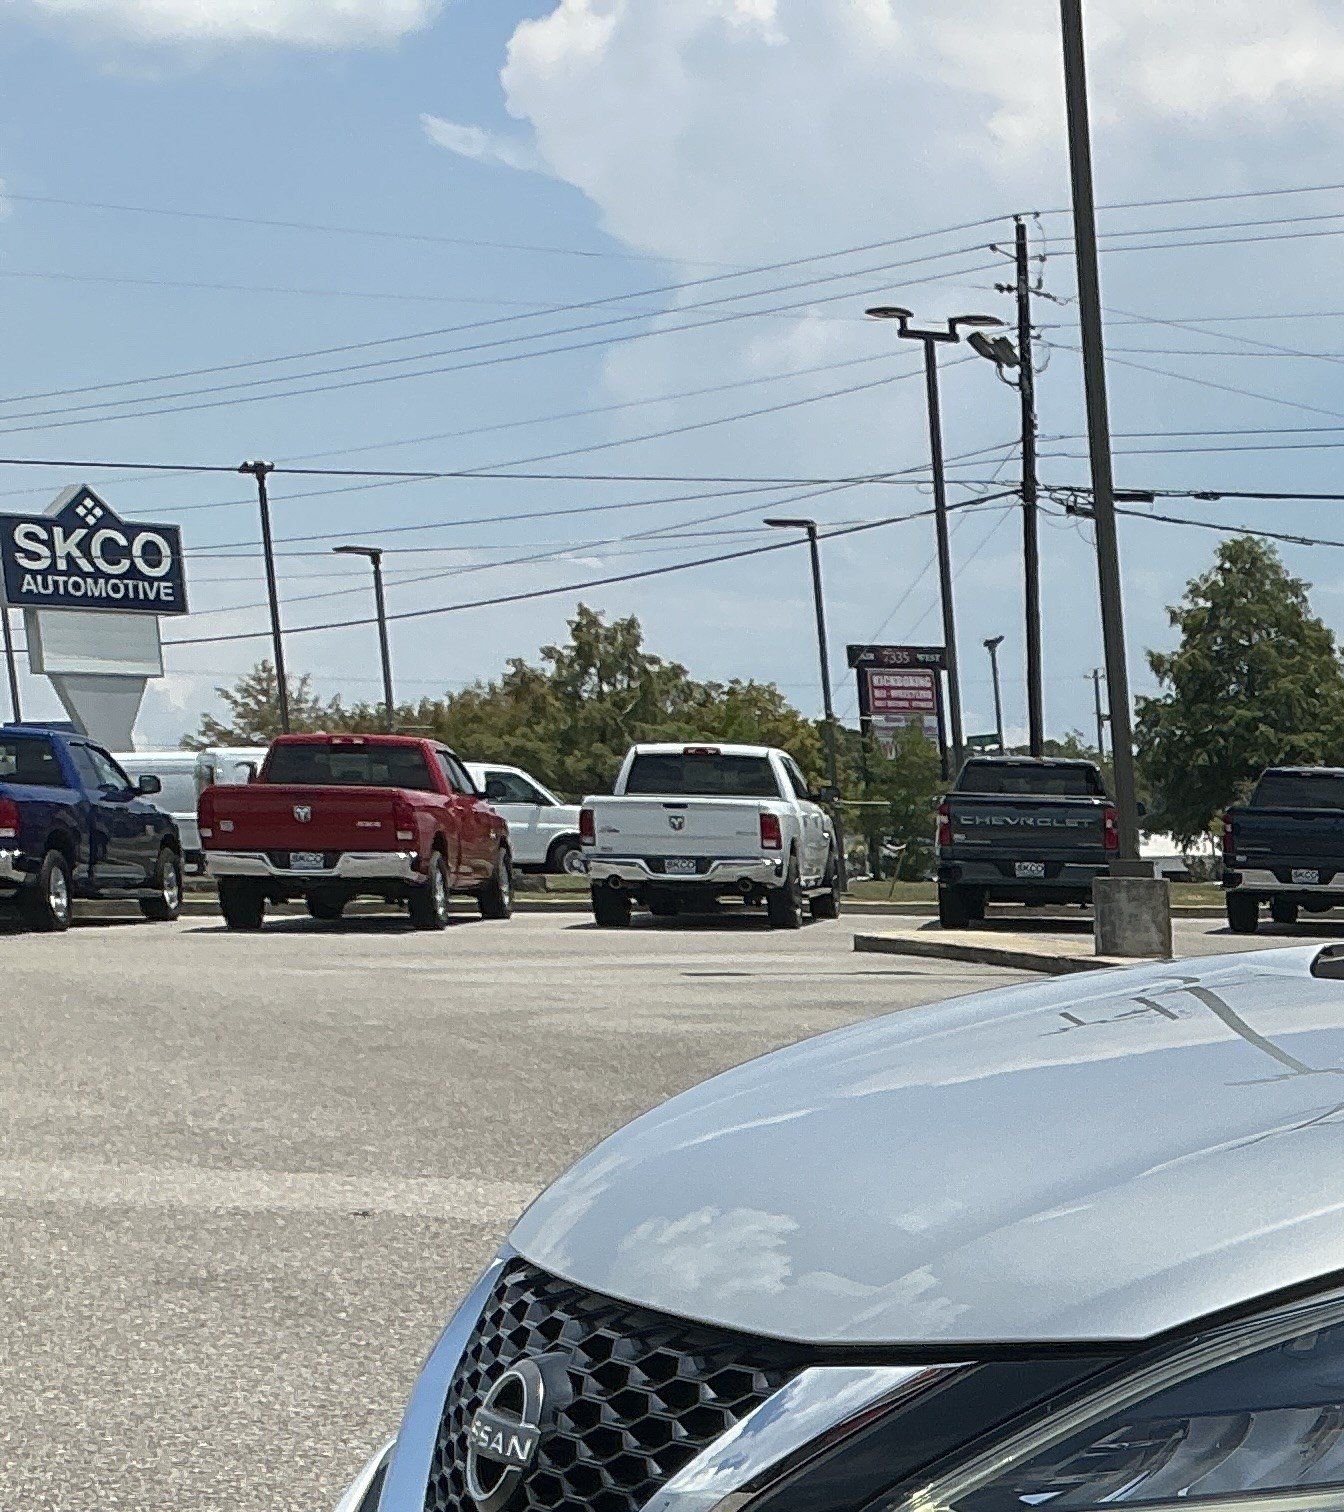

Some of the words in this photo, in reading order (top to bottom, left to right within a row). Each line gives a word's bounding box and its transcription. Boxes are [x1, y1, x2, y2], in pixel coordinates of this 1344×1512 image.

[14, 523, 172, 577] SKCO
[21, 574, 175, 601] AUTOMOTIVE
[960, 815, 1095, 828] CHEVROLET
[471, 1420, 532, 1460] SSAN
